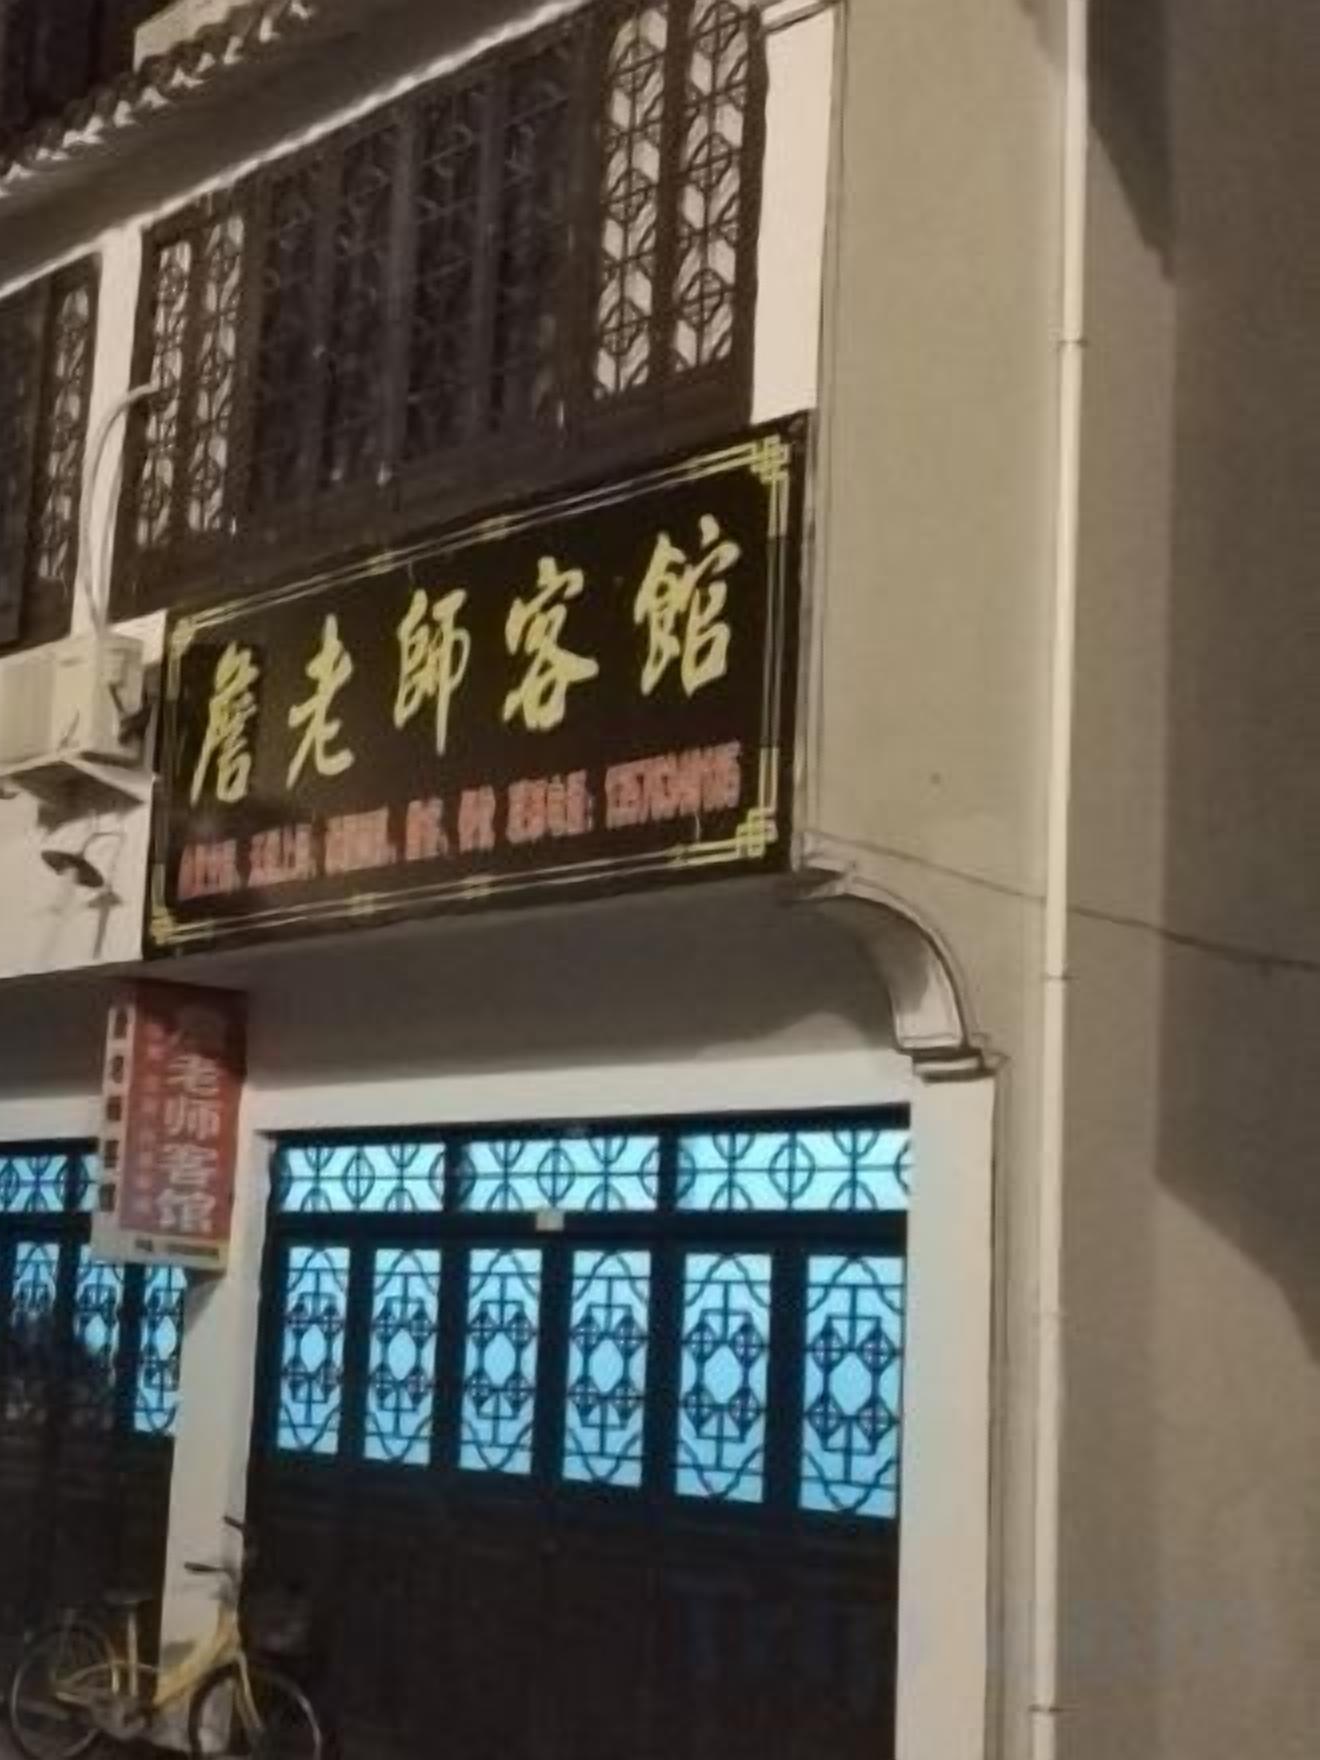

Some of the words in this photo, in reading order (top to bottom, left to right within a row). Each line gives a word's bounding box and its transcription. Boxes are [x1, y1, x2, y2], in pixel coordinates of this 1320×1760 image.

[192, 513, 741, 806] 詹老師客館
